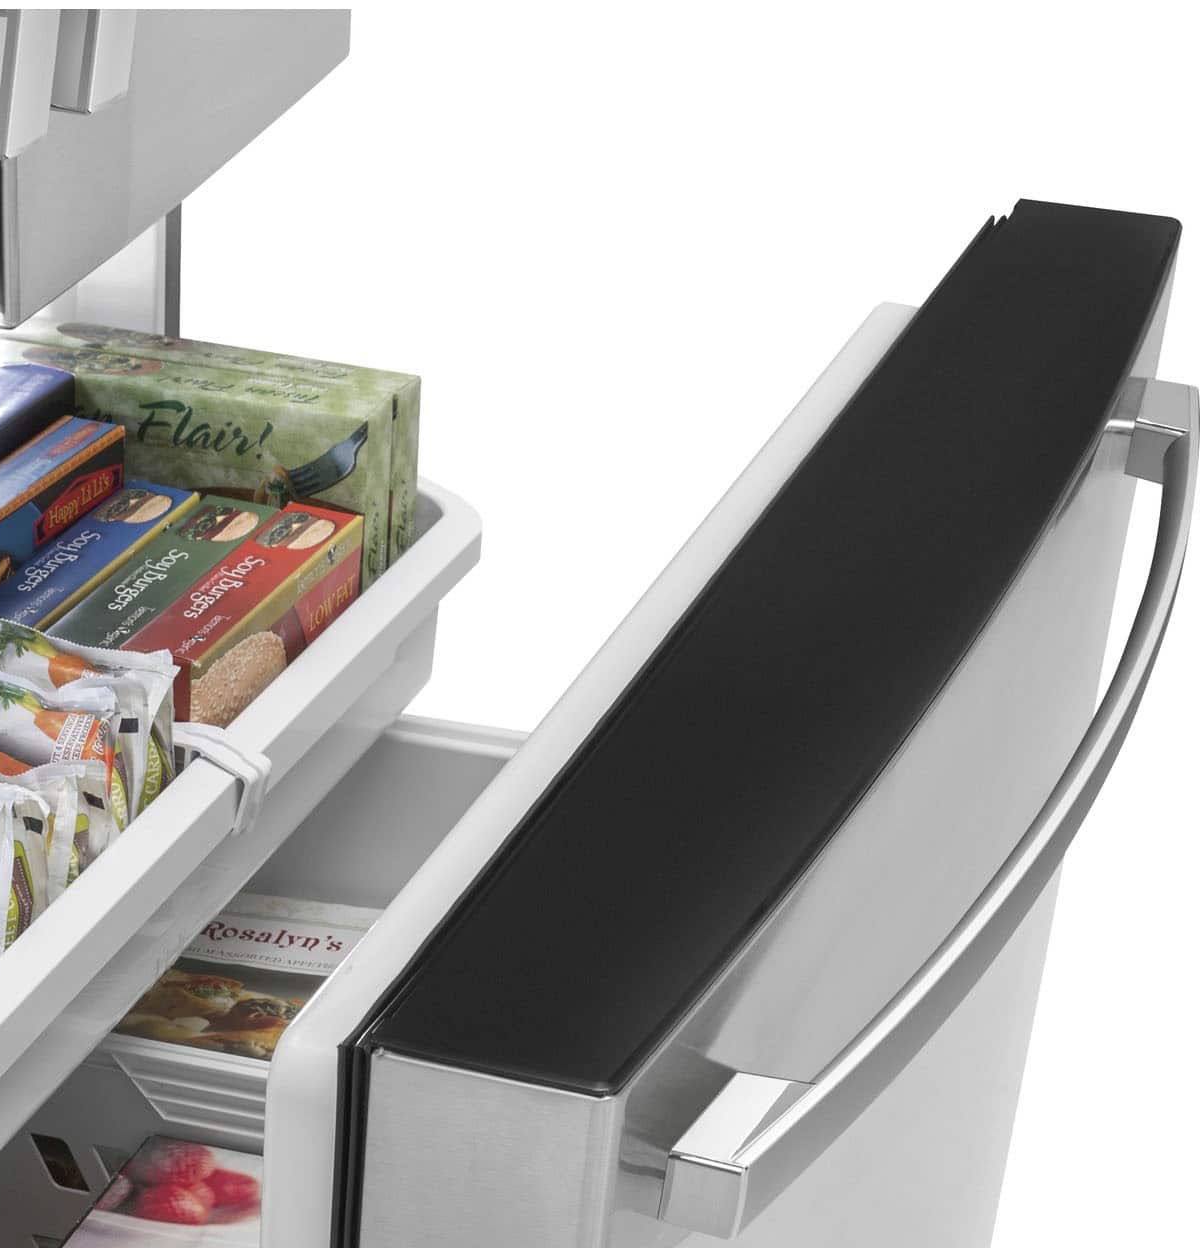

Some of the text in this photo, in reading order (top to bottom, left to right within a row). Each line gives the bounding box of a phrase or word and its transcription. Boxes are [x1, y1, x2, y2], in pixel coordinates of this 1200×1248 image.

[136, 399, 274, 460] Flair!
[57, 529, 102, 552] Soy
[144, 548, 190, 572] Soy
[17, 551, 79, 592] Burgers
[220, 555, 266, 579] Soy
[108, 569, 168, 612] Burgers
[183, 578, 244, 620] Burgers
[308, 575, 356, 633] LOW FAT
[200, 920, 344, 952] Rosalyn's
